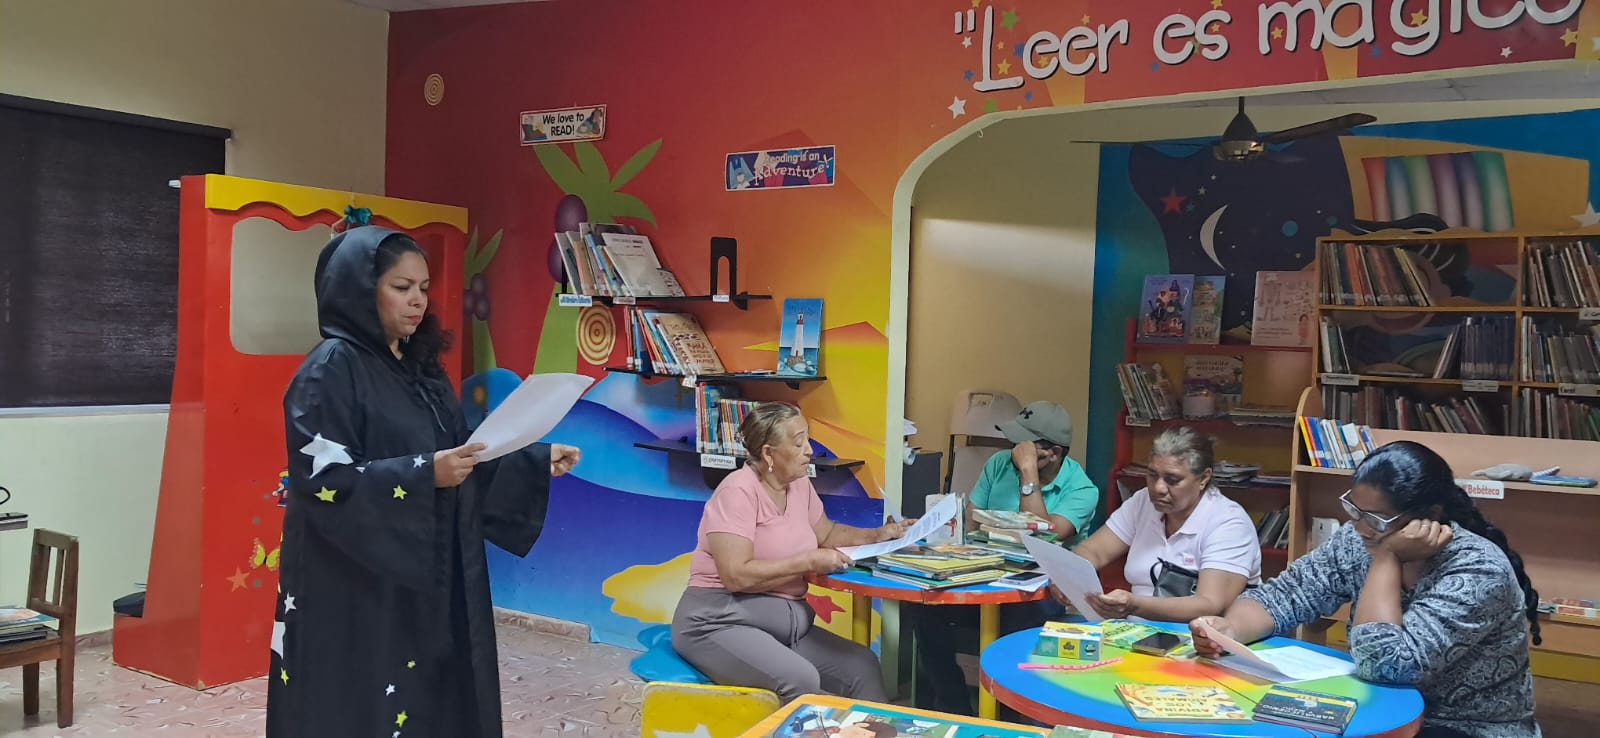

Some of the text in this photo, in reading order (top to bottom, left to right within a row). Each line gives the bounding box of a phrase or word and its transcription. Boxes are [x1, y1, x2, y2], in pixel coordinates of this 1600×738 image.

[1153, 9, 1232, 65] es
[542, 112, 585, 125] We love to
[550, 125, 575, 137] READ!
[808, 152, 820, 161] an
